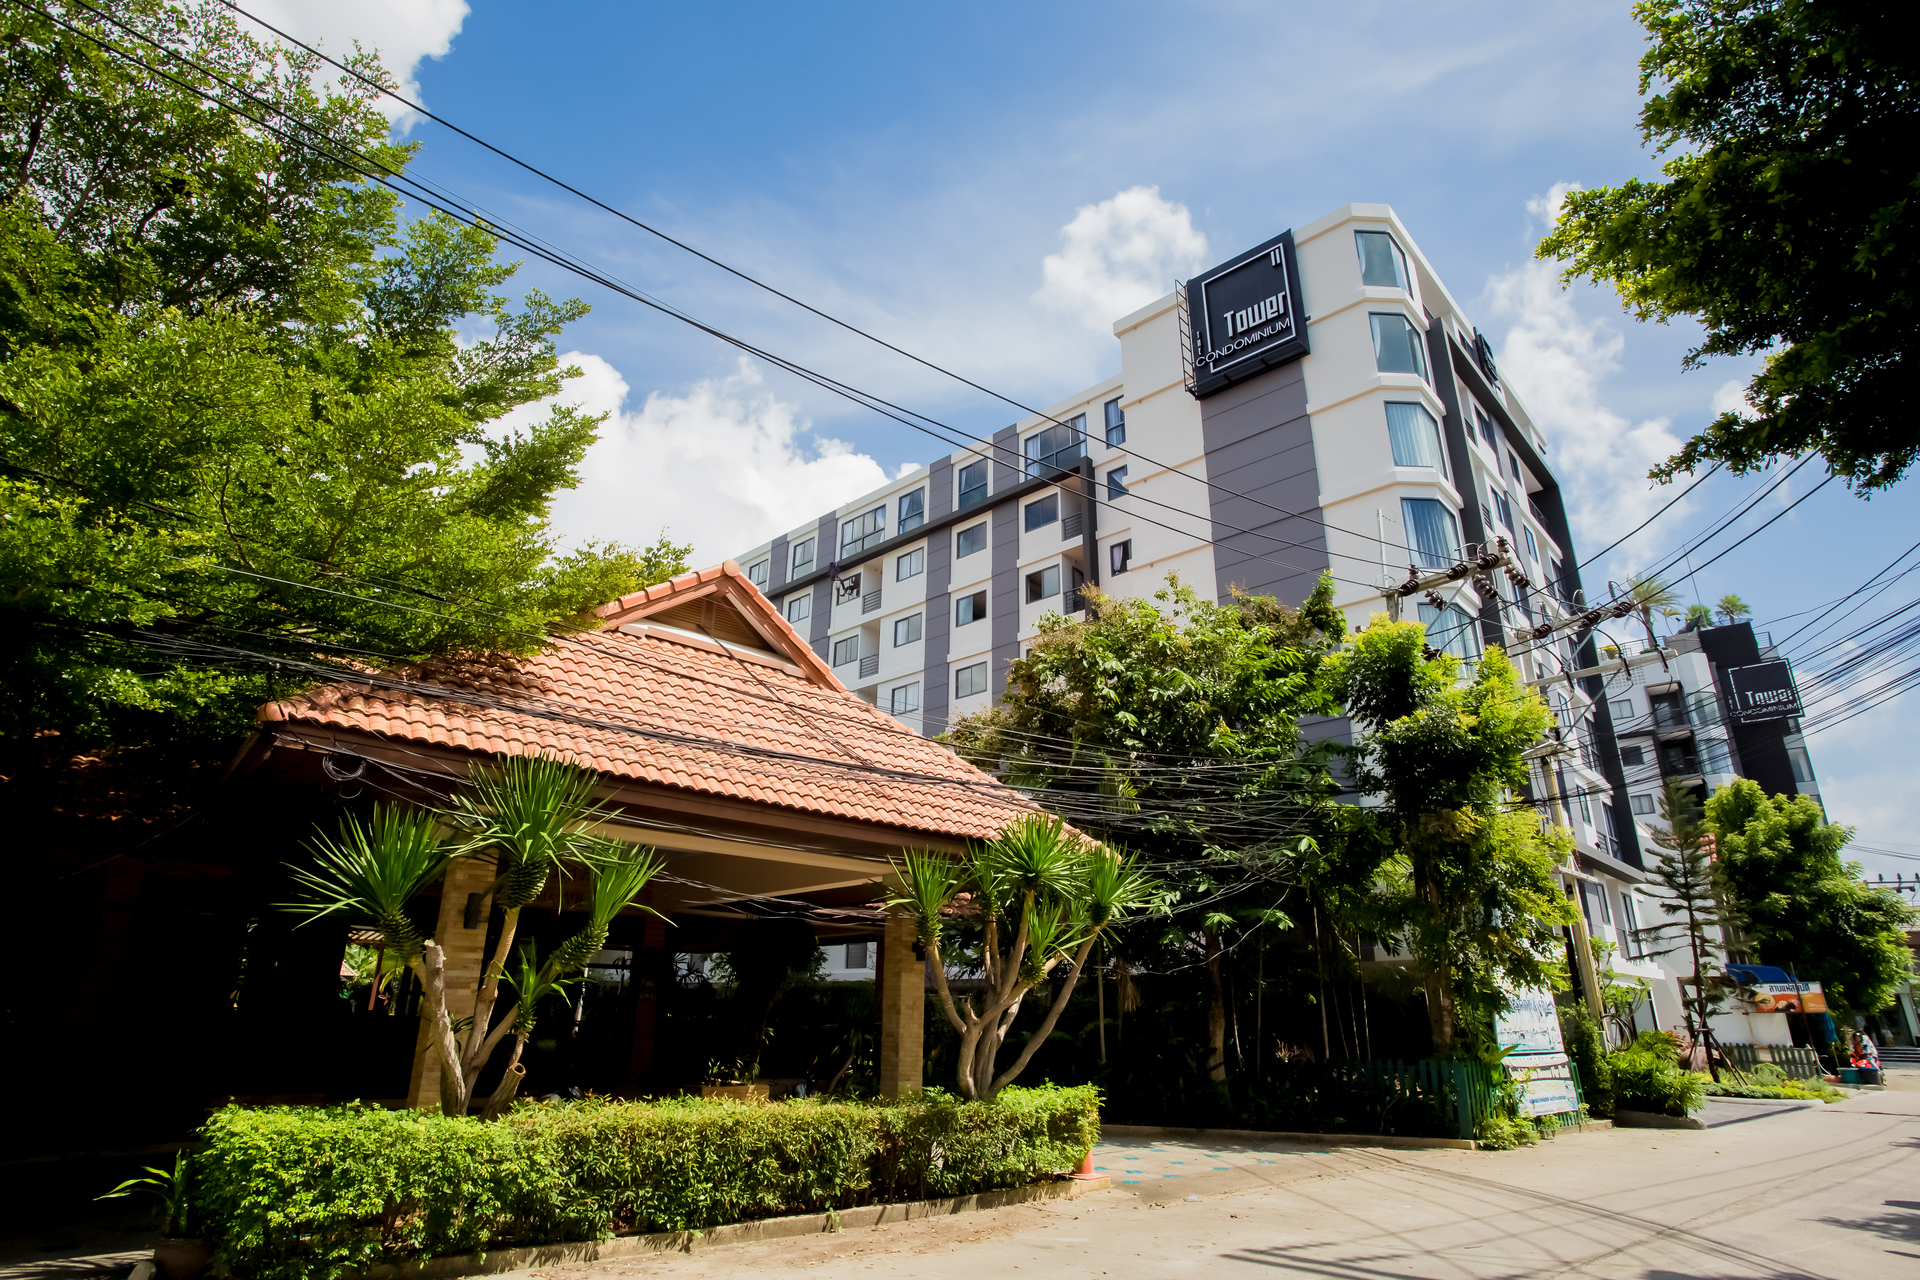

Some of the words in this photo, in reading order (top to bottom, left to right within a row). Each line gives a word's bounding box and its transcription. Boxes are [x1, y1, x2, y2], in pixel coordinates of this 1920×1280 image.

[1223, 291, 1286, 338] Tower
[1195, 317, 1291, 367] CONDOMINIUM
[1730, 702, 1799, 718] CONDOMINIUM
